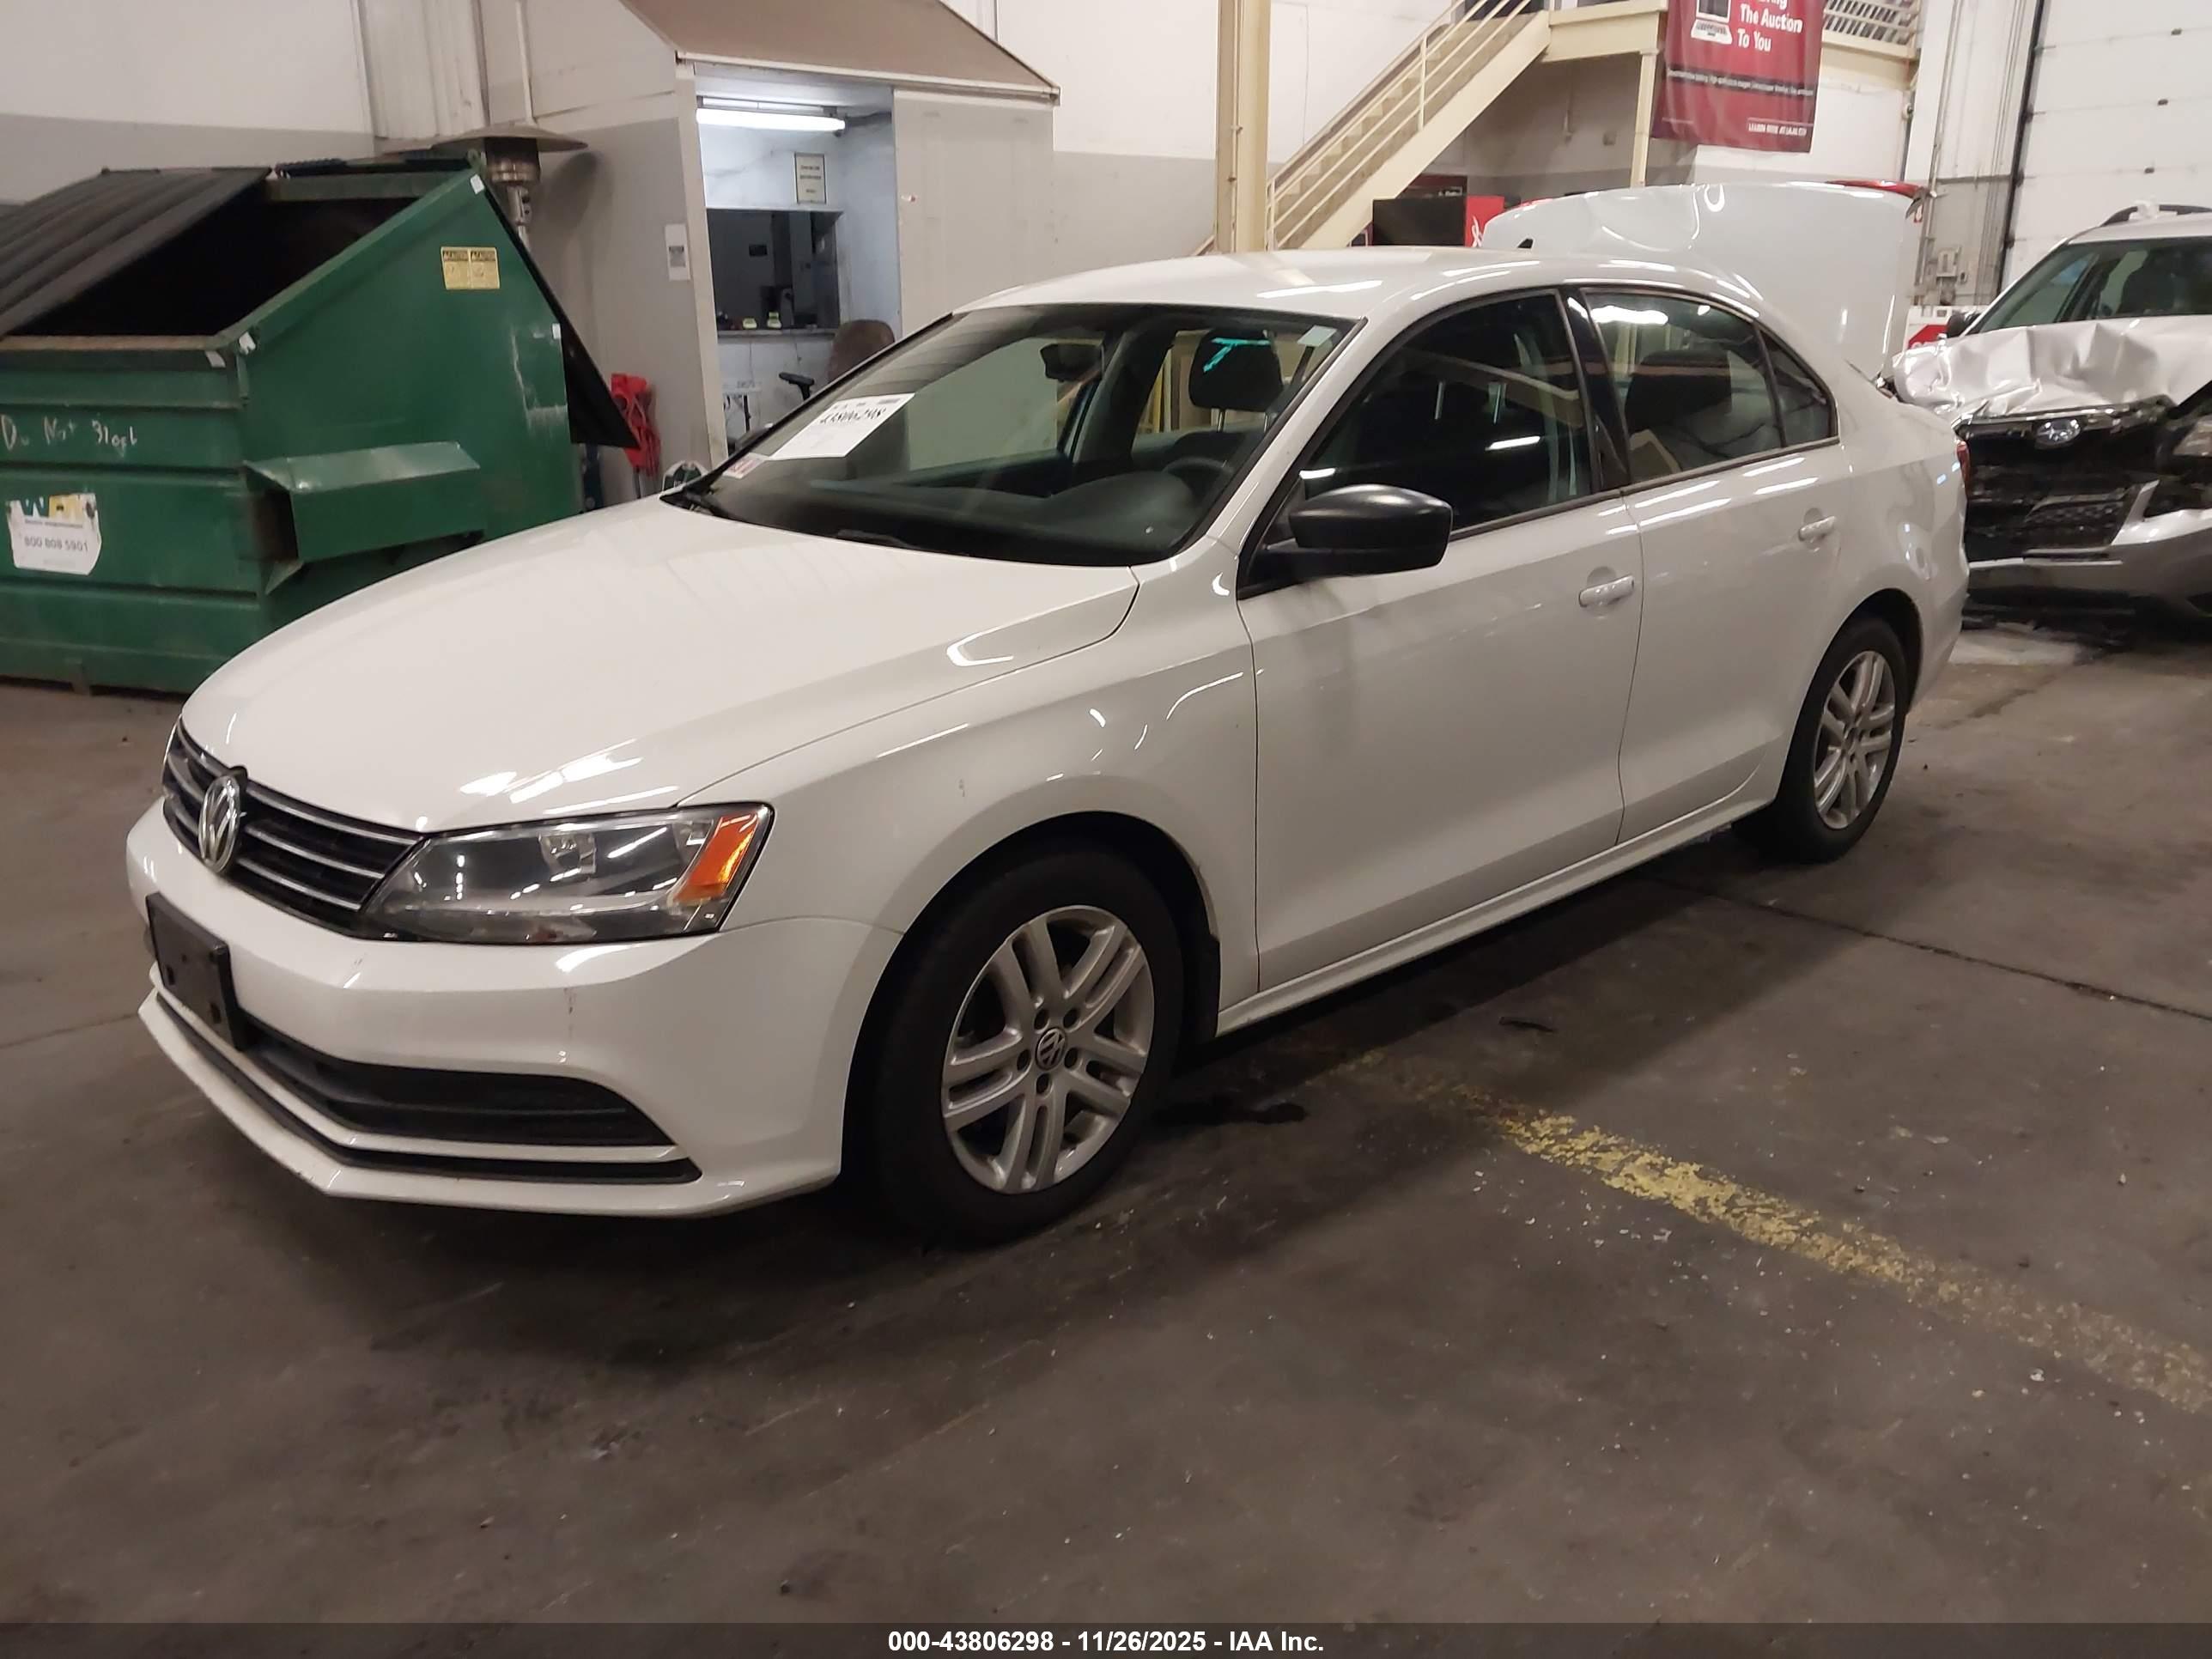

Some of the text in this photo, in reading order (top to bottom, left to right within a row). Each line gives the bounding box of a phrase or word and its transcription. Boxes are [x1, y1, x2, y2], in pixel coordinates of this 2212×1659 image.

[1740, 3, 1759, 25] The
[1760, 8, 1803, 33] Auction
[1737, 27, 1772, 52] To You
[24, 535, 43, 548] 800
[64, 539, 88, 552] 5901
